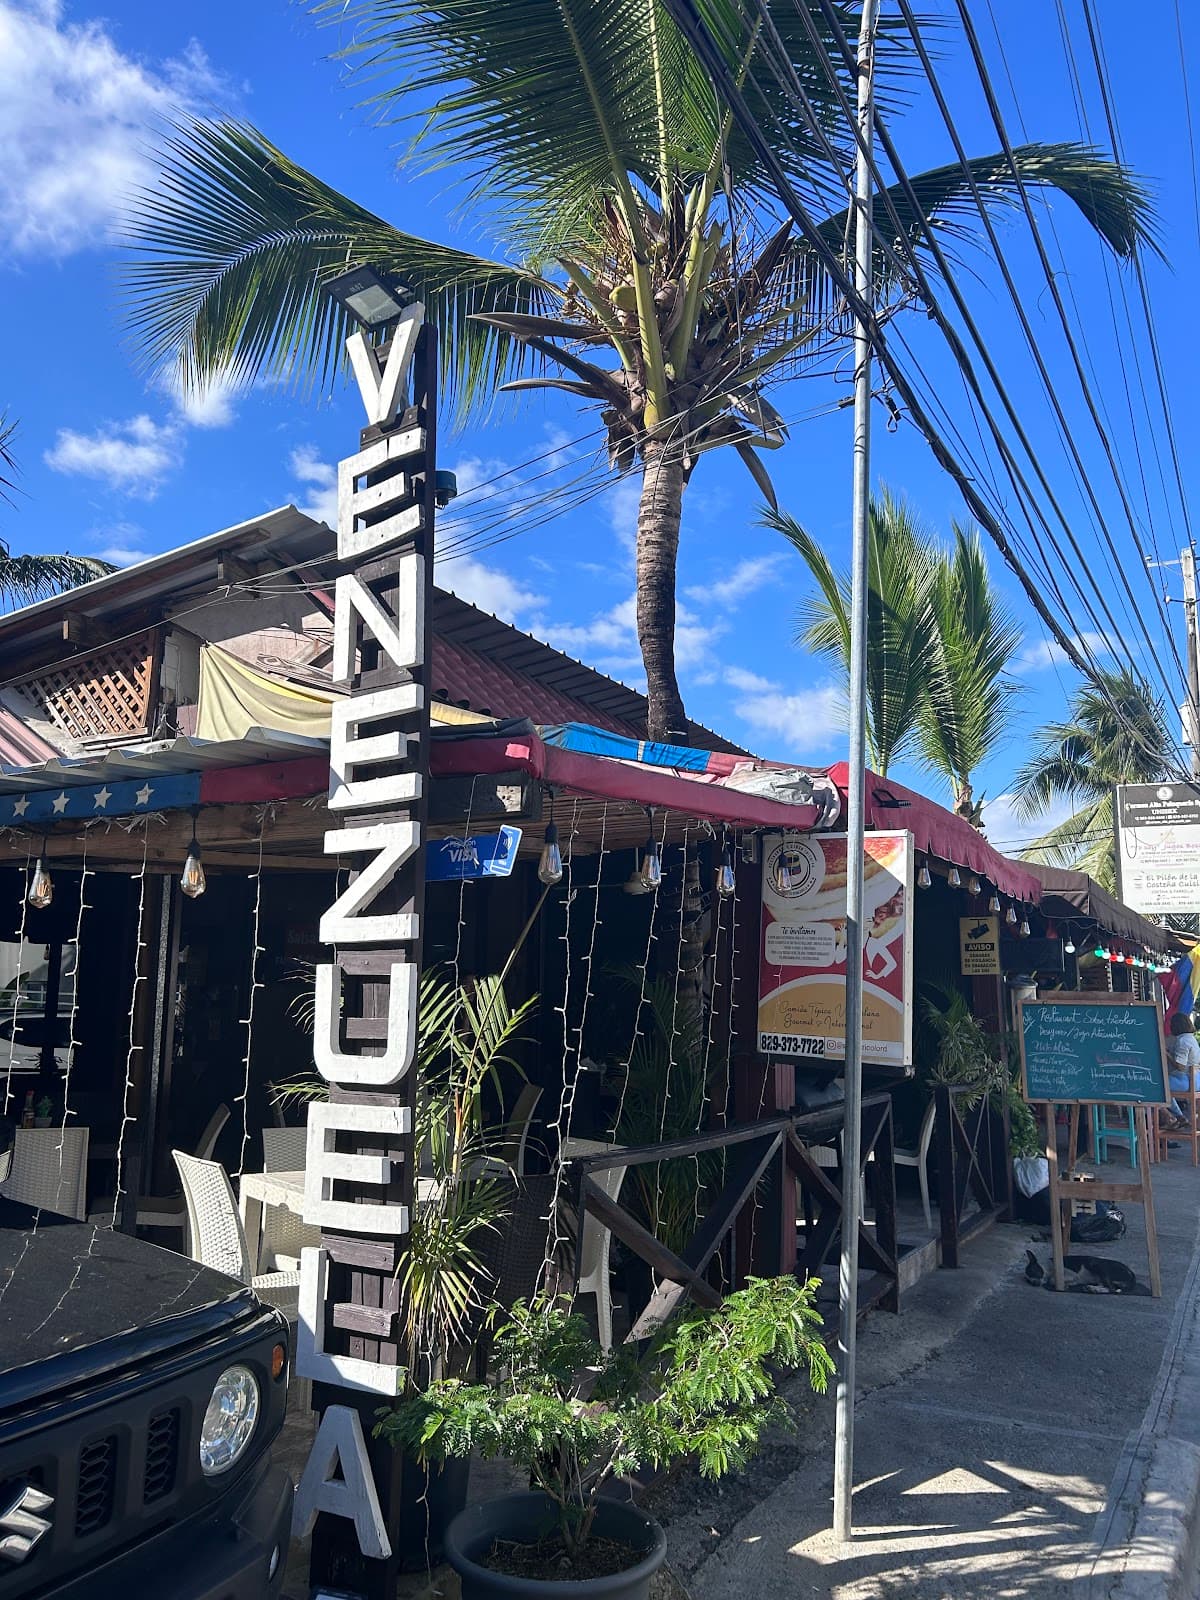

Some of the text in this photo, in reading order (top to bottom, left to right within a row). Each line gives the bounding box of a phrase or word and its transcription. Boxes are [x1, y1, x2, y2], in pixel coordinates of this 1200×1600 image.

[448, 848, 478, 862] VISA
[291, 301, 425, 1559] VENEZUELA
[761, 1034, 824, 1055] 829-373-7722
